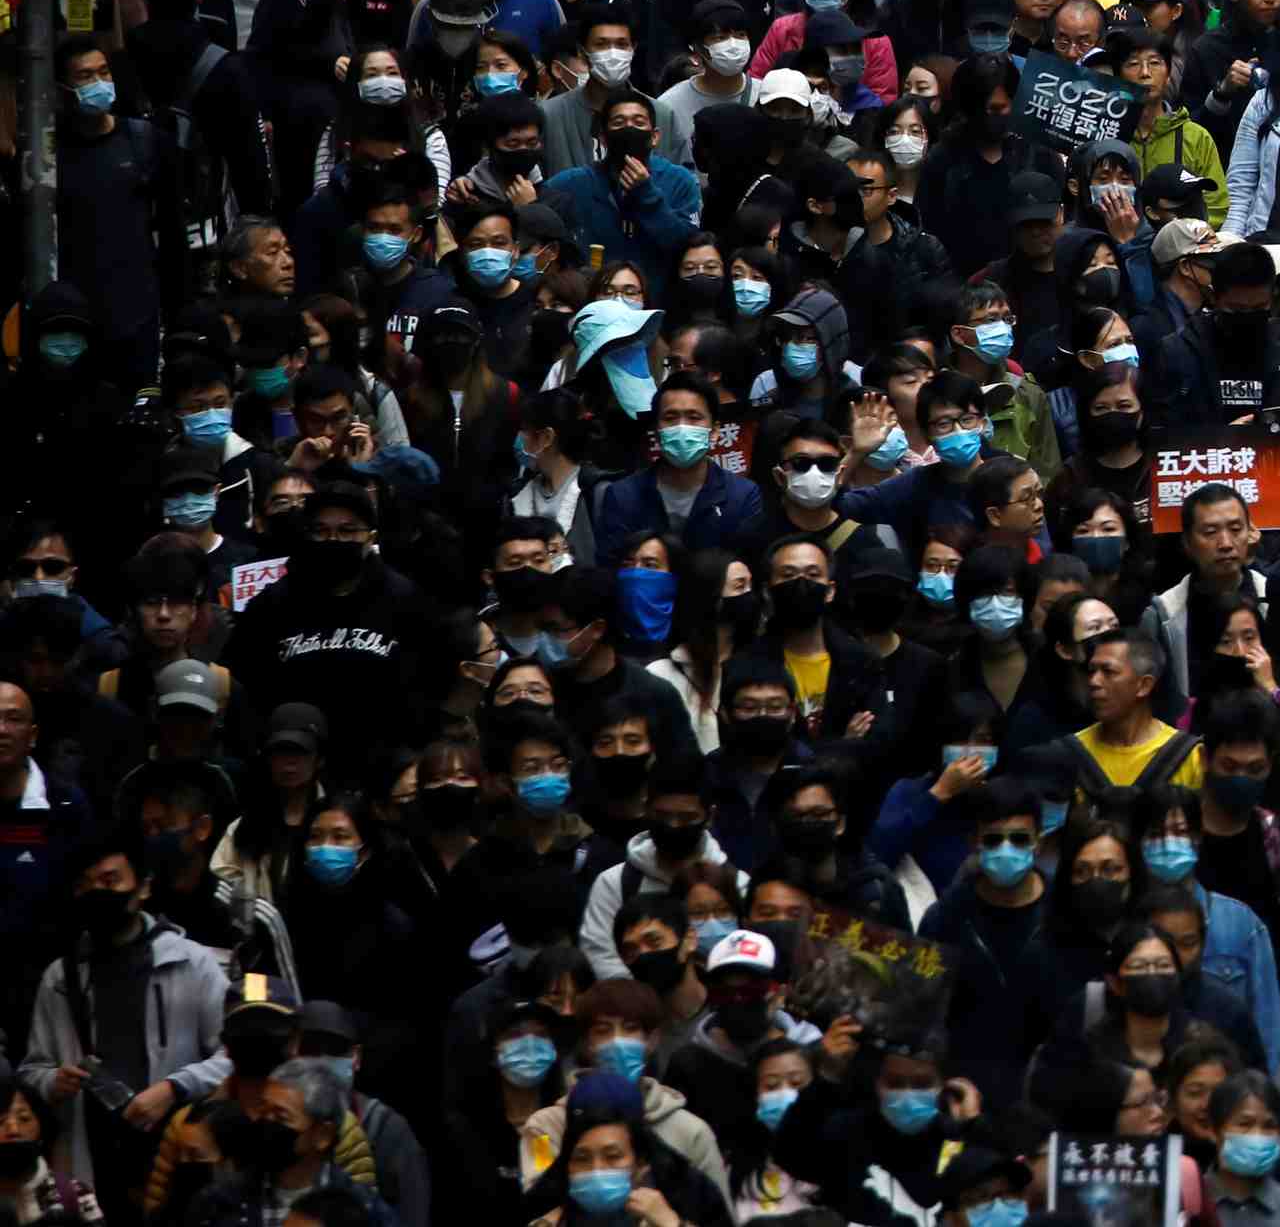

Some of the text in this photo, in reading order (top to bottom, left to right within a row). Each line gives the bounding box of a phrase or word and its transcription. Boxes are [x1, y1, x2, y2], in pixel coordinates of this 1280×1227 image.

[1032, 71, 1129, 122] 2020
[1022, 94, 1123, 143] 光復香港
[1156, 446, 1257, 476] 五大訴求
[1157, 474, 1260, 507] 堅持底
